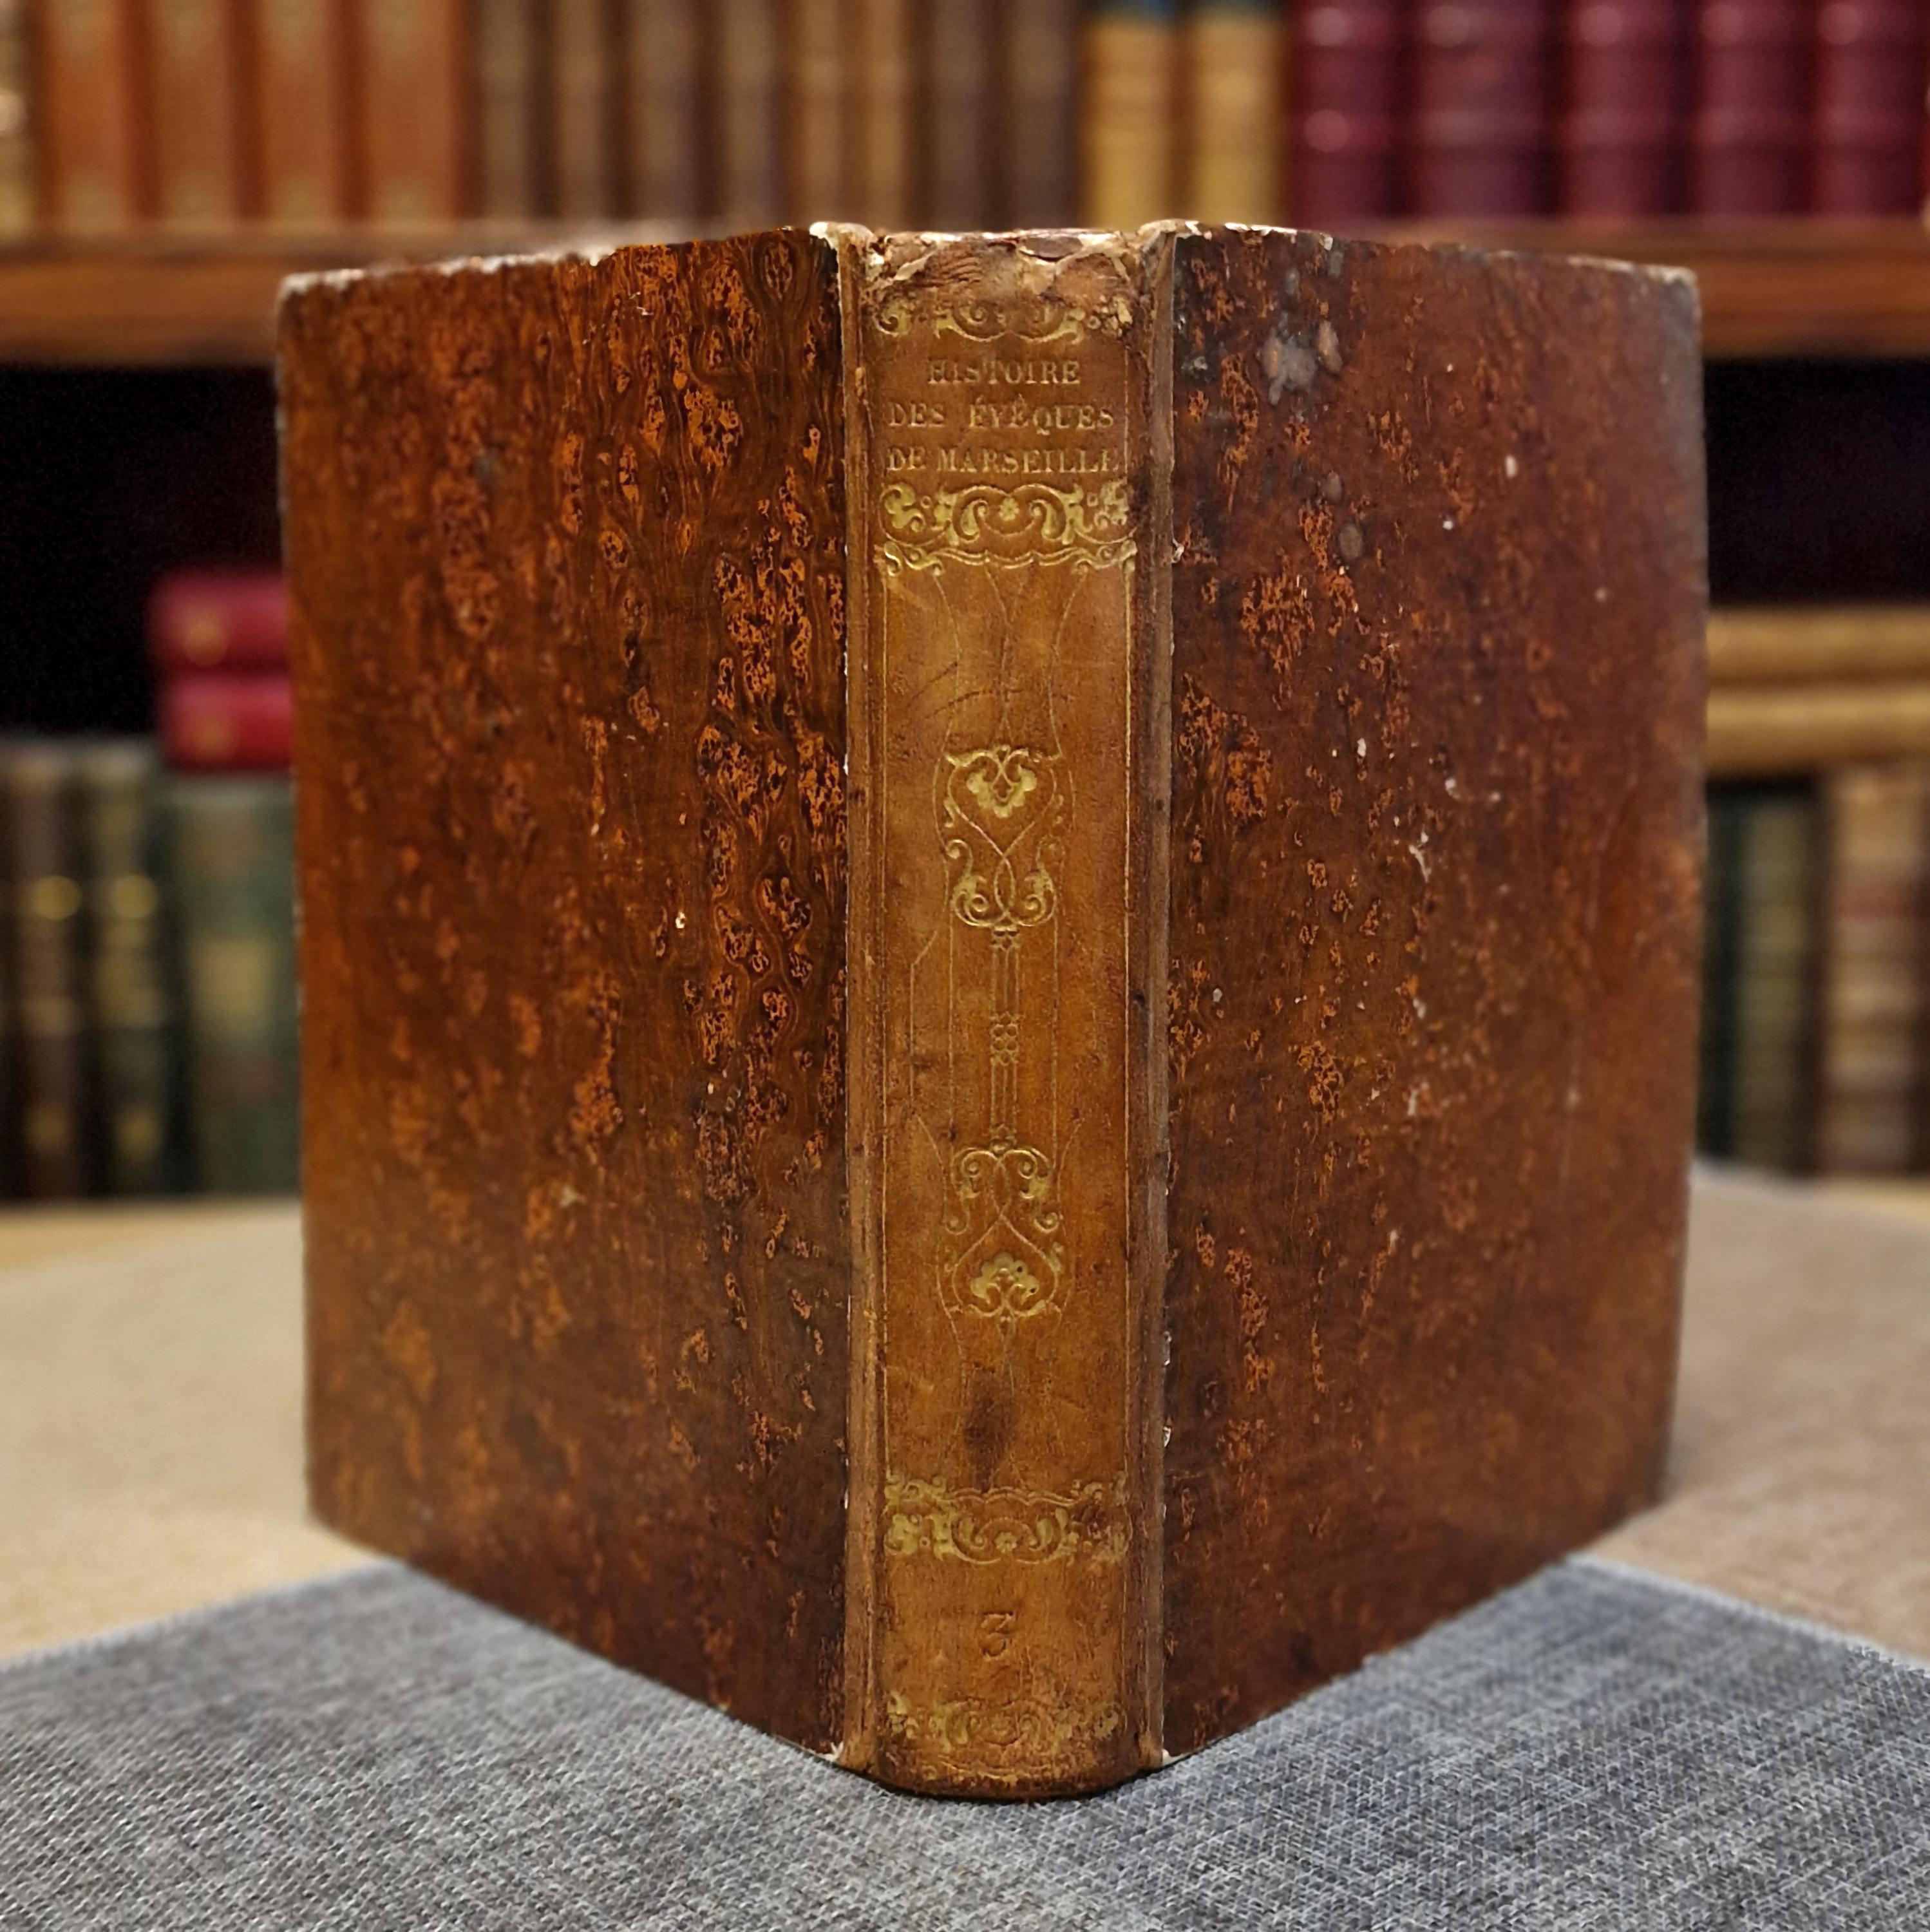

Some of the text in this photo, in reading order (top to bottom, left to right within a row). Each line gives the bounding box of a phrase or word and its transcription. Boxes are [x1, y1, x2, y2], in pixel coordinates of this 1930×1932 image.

[928, 358, 1081, 385] HISTOIRE
[887, 402, 946, 428] DES
[886, 448, 926, 471] DE
[979, 1611, 1015, 1662] 3
